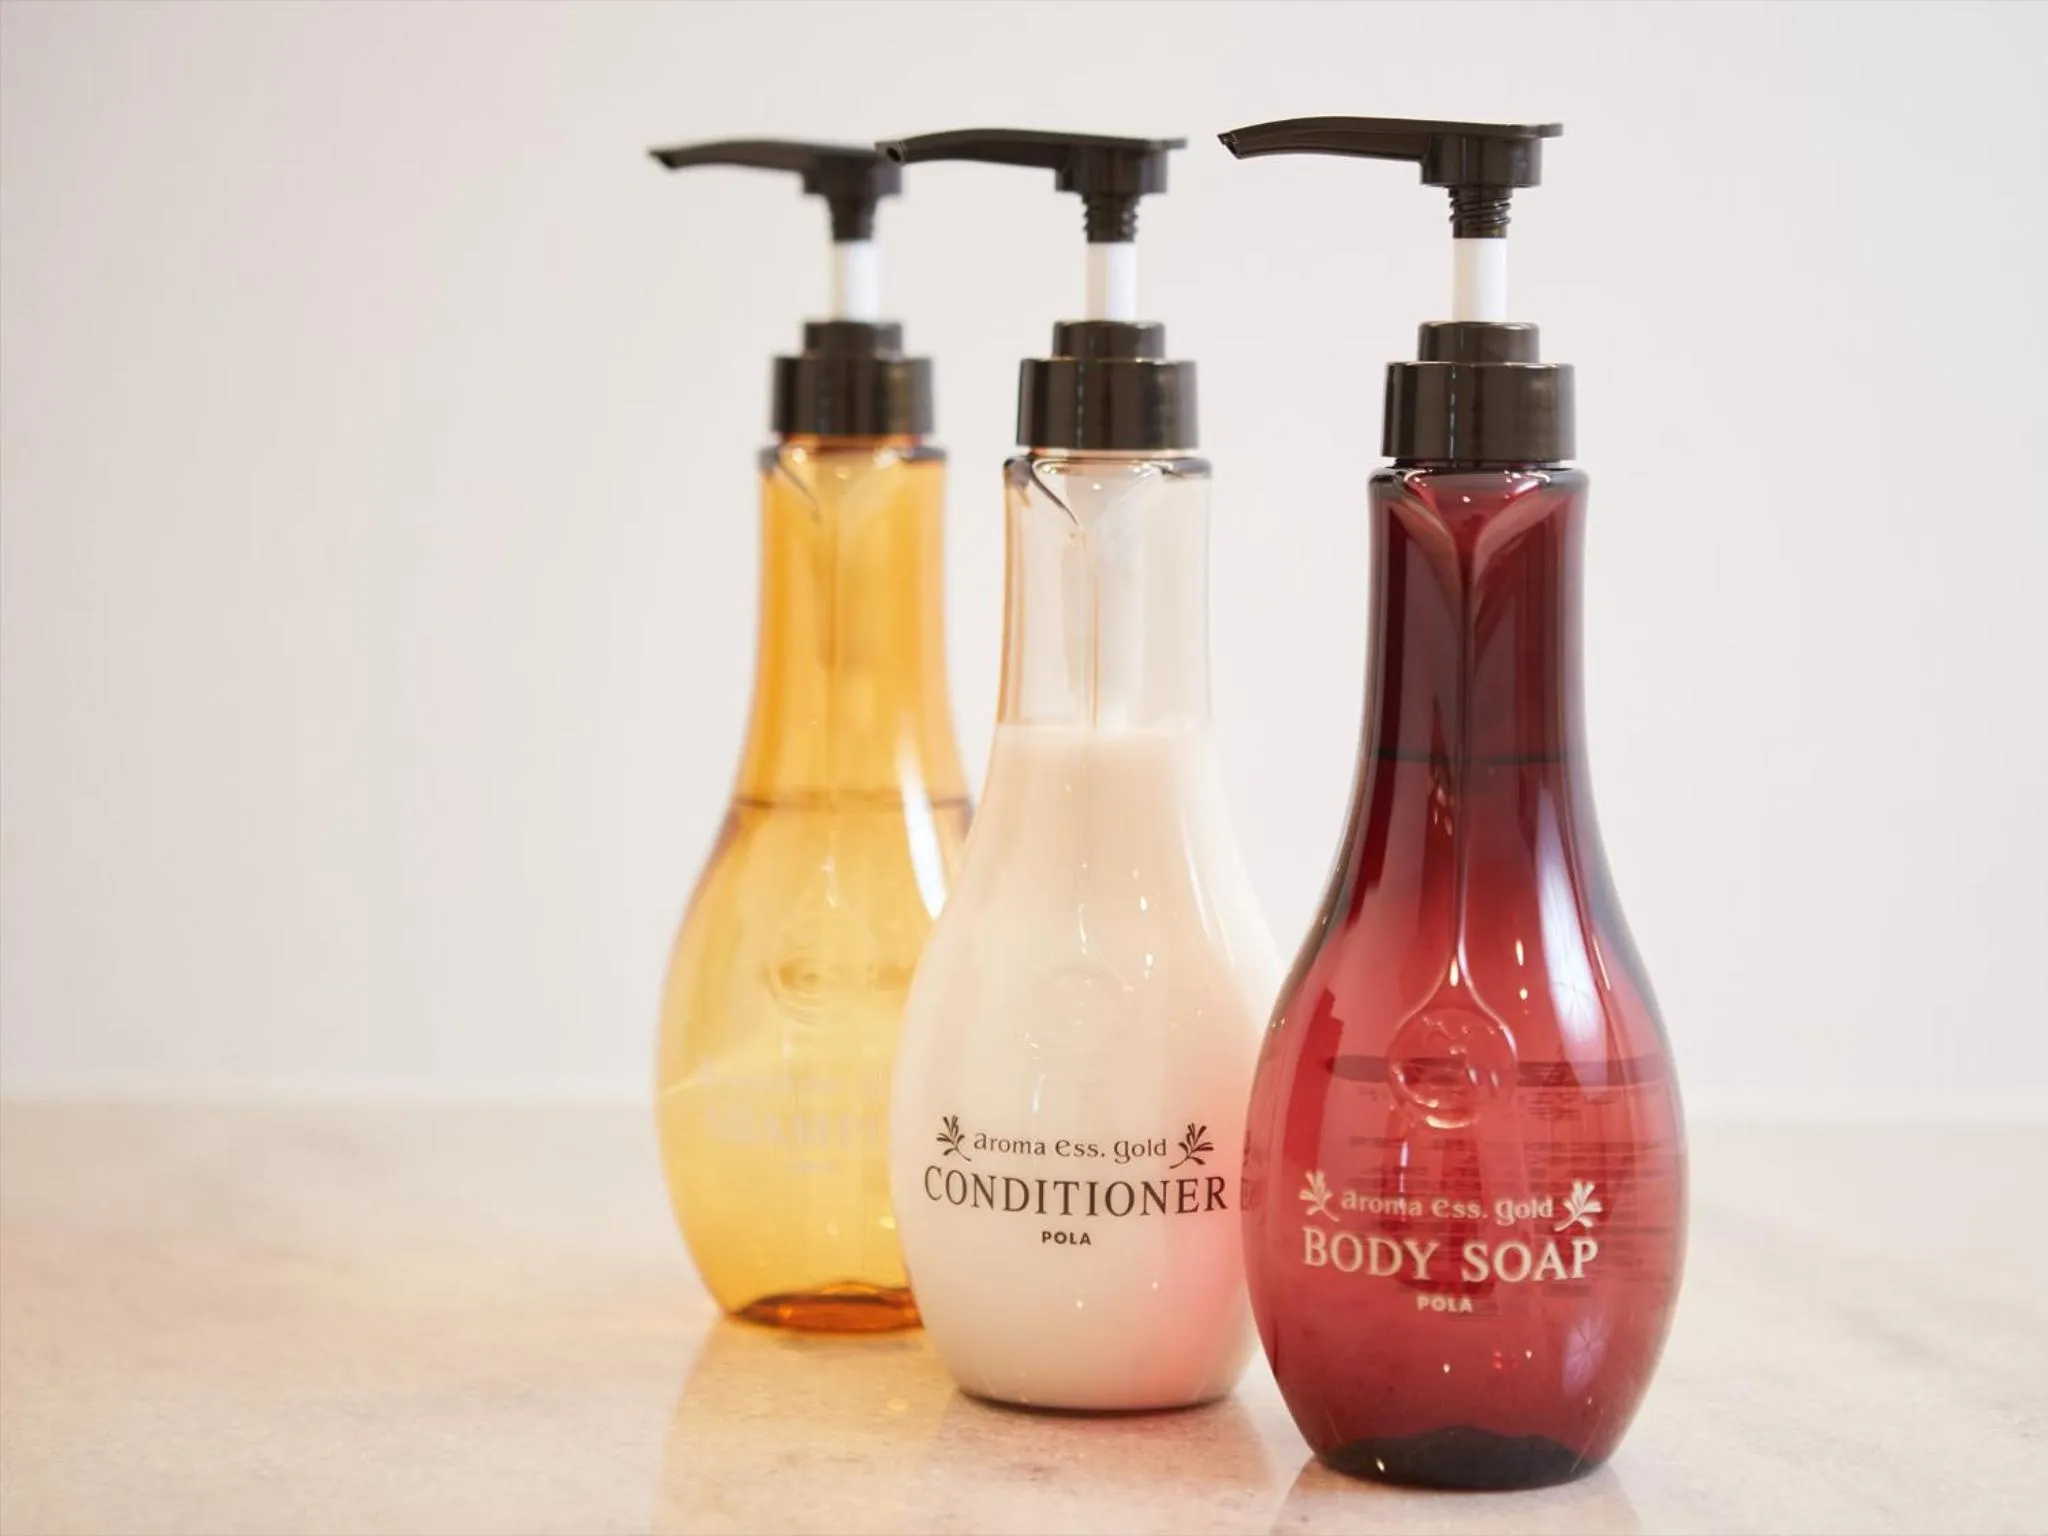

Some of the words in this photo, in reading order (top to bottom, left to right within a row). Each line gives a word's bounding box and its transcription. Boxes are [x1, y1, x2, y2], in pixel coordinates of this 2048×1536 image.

[973, 1132, 1046, 1156] aroma
[1055, 1138, 1106, 1158] ess.
[1113, 1138, 1167, 1165] gold
[924, 1164, 1229, 1217] CONDITIONER
[1340, 1189, 1423, 1217] aroma
[1431, 1197, 1488, 1220] ess.
[1495, 1197, 1554, 1226] gold
[1041, 1230, 1092, 1246] POLA
[1302, 1226, 1441, 1281] BODY
[1461, 1238, 1599, 1283] SOAP
[1416, 1293, 1474, 1314] POLA
